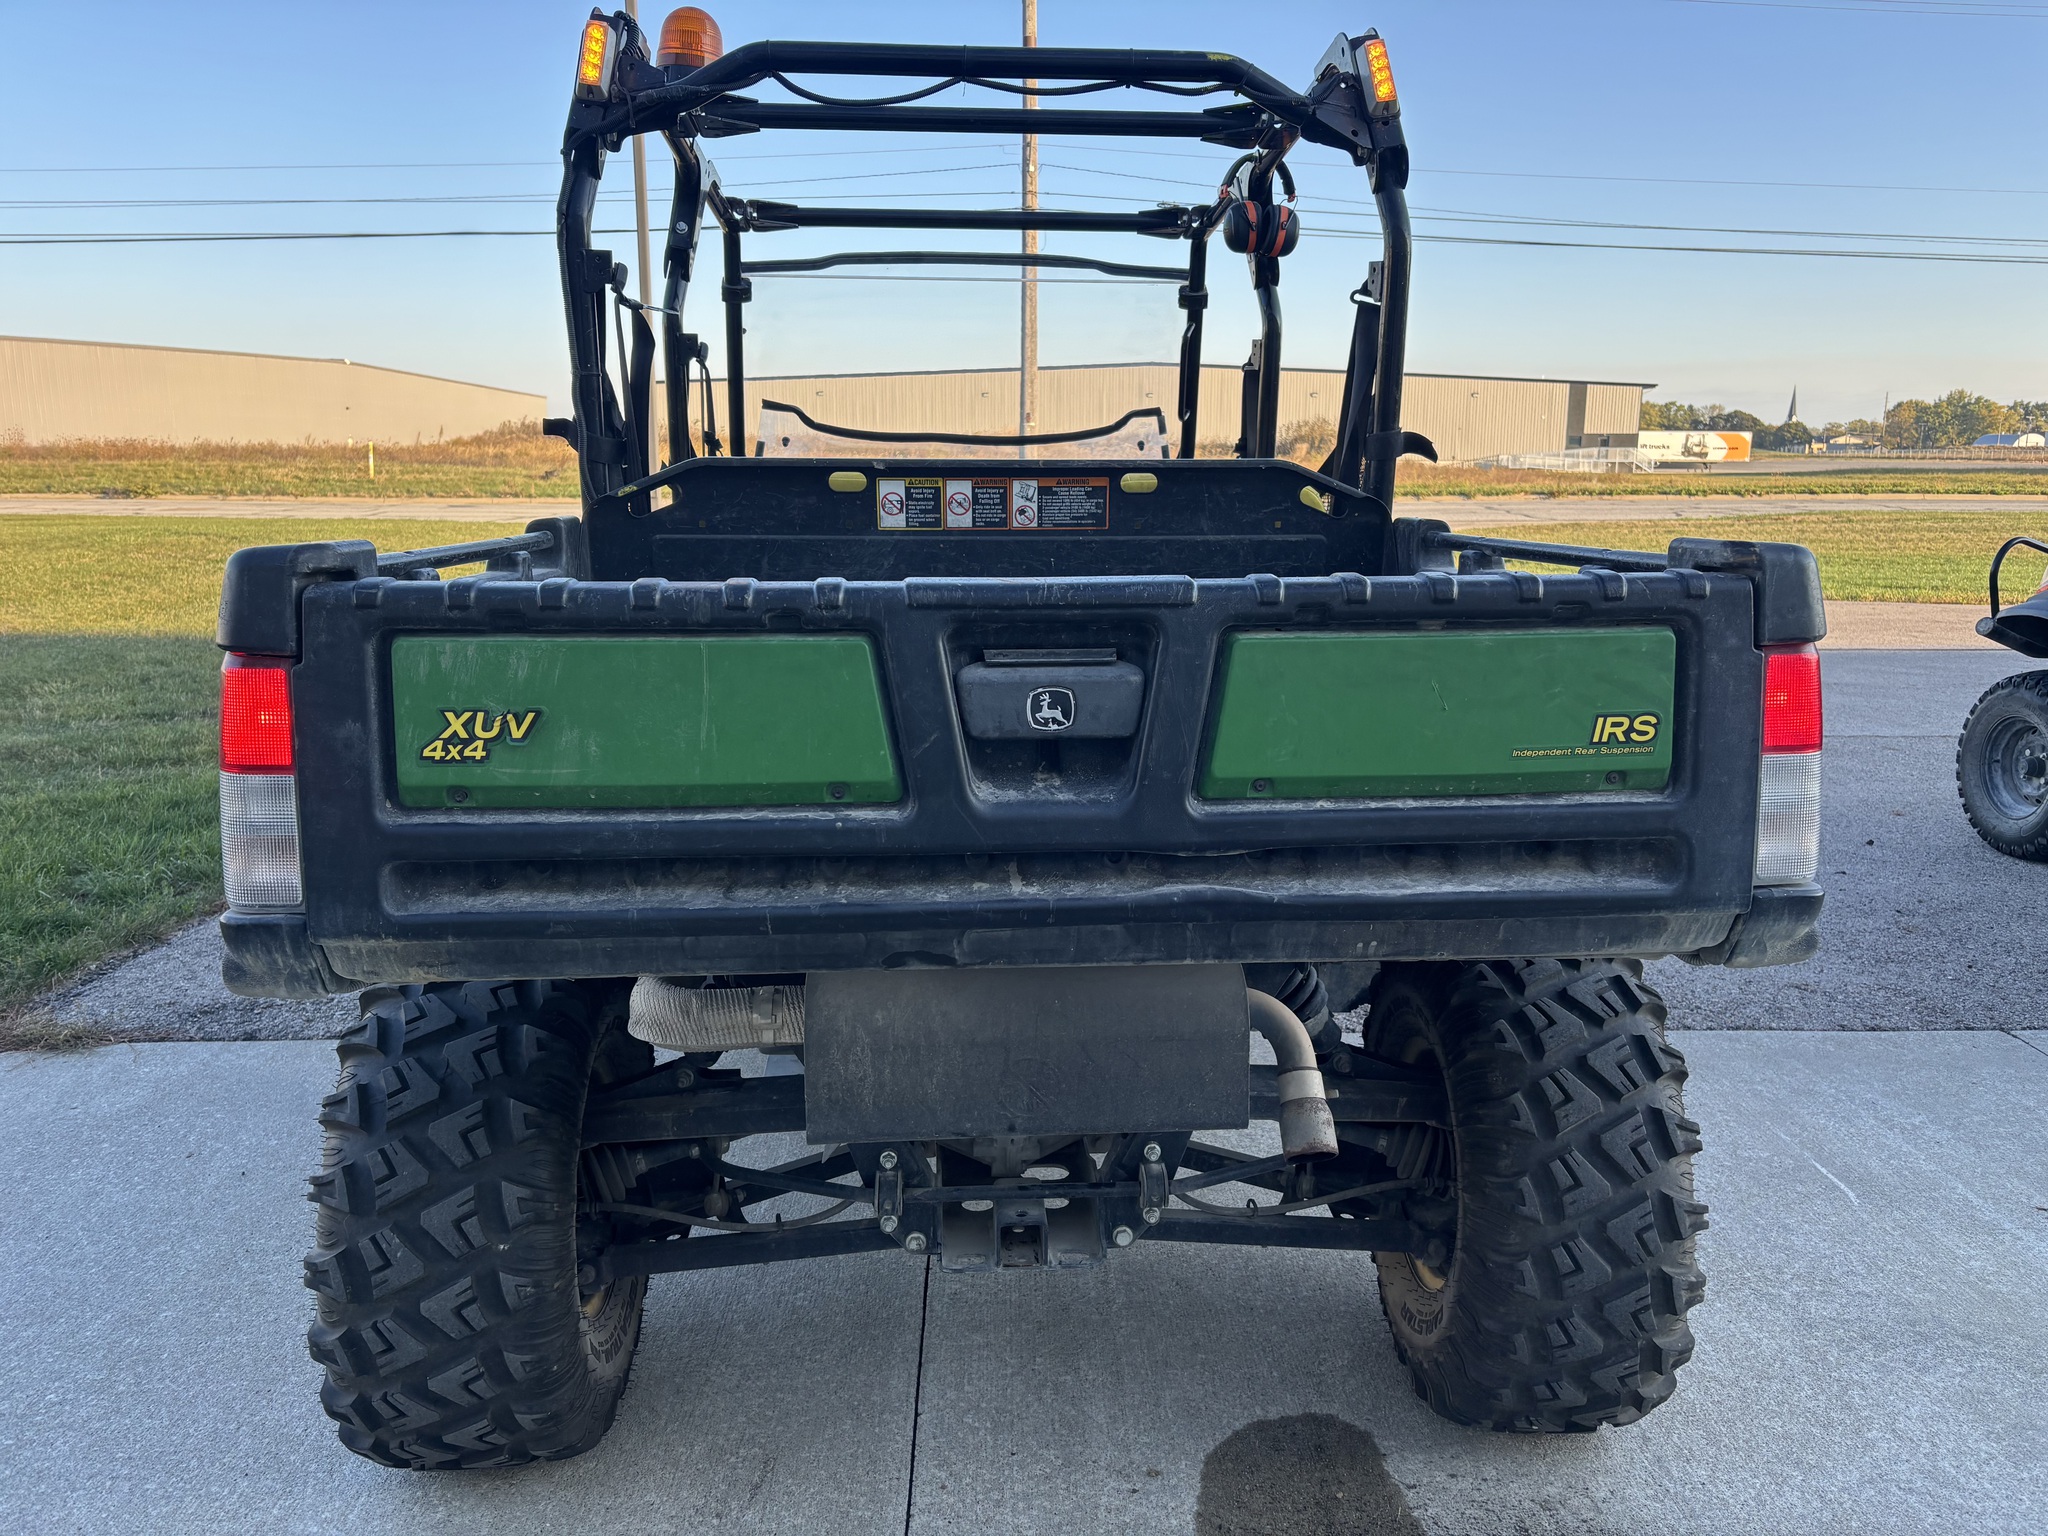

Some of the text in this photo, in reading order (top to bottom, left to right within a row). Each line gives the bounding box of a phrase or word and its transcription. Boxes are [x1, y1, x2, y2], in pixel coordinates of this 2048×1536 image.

[438, 710, 537, 739] XUV
[1592, 715, 1658, 743] IRS
[422, 739, 487, 761] 4x4
[1512, 745, 1654, 758] Independent Rear Suspension
